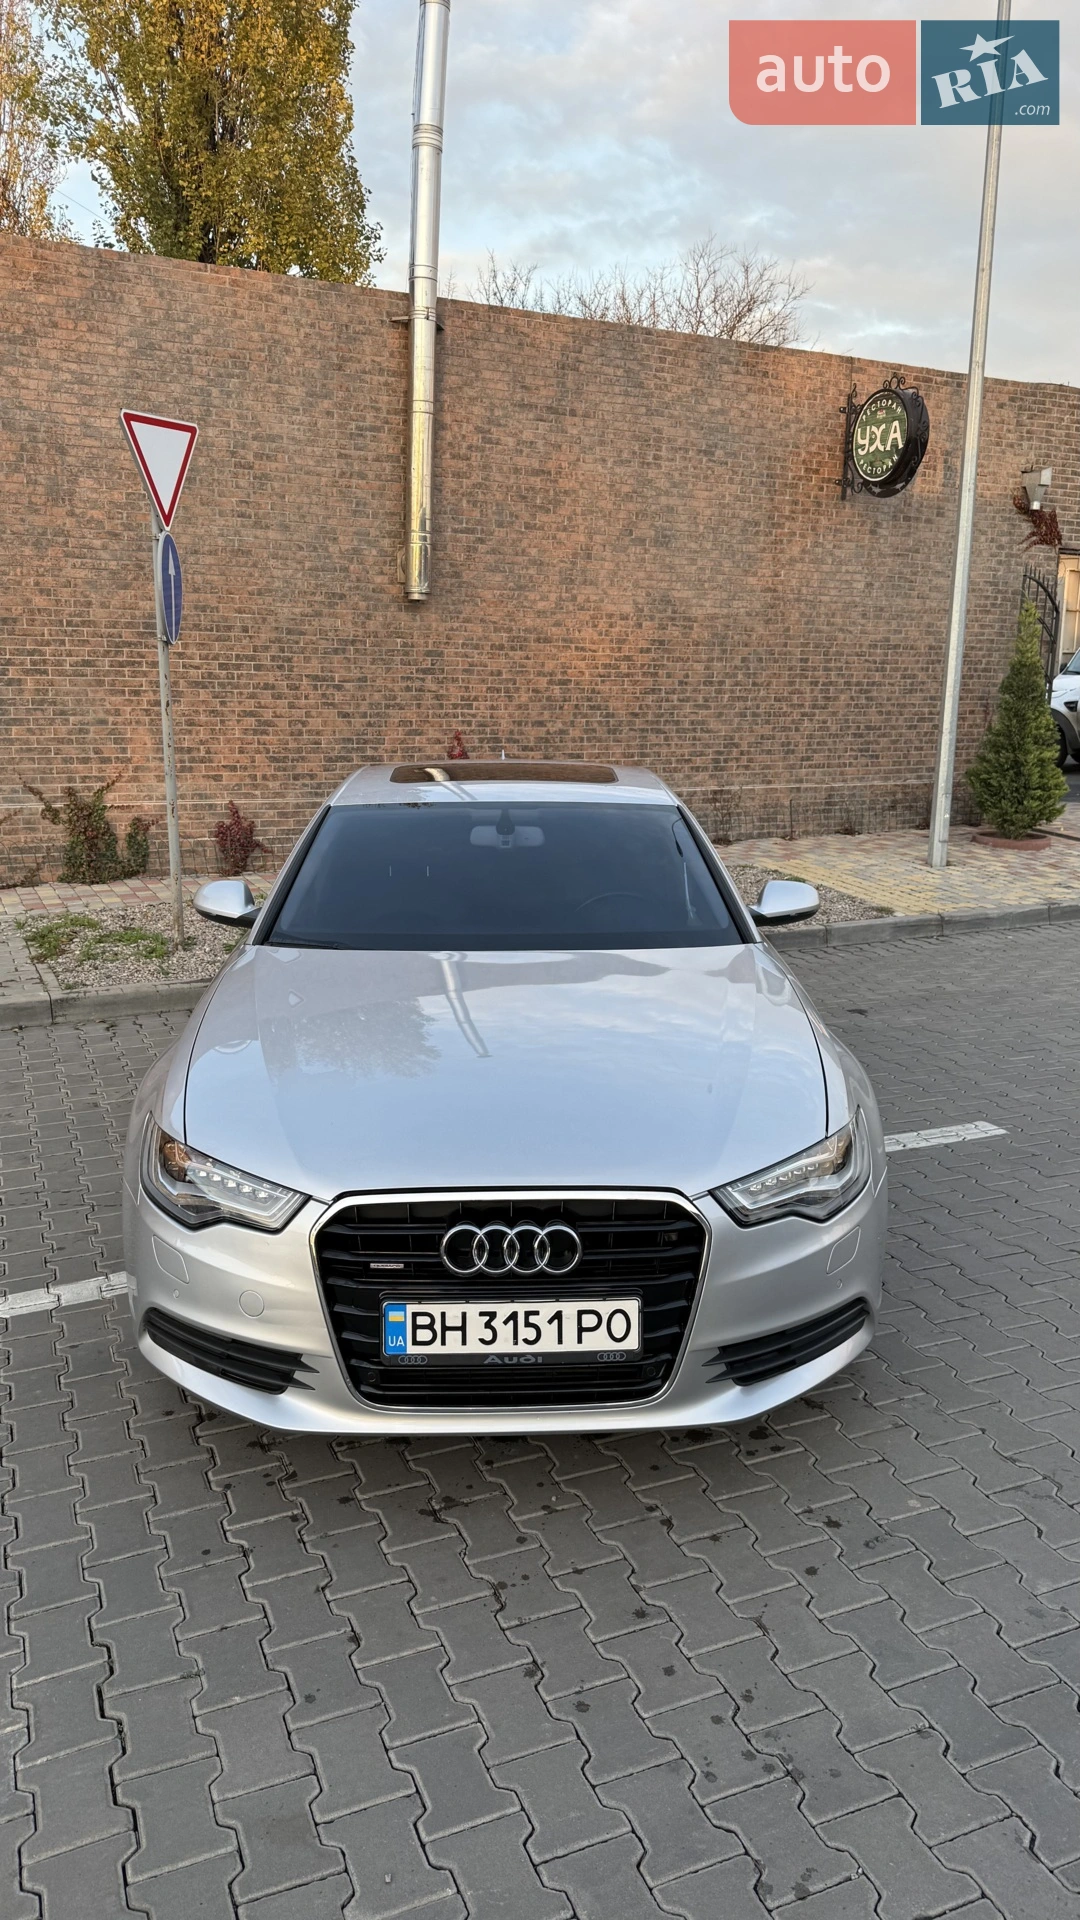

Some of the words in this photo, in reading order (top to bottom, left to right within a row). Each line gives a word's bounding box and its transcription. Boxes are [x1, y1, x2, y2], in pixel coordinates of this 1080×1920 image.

[862, 399, 902, 421] РЕСТОРАН
[859, 453, 899, 475] РЕСТОРАН
[411, 1311, 467, 1346] BH
[478, 1310, 563, 1346] 3151
[577, 1308, 632, 1345] PO
[388, 1335, 405, 1347] UA
[483, 1354, 543, 1364] Audi
